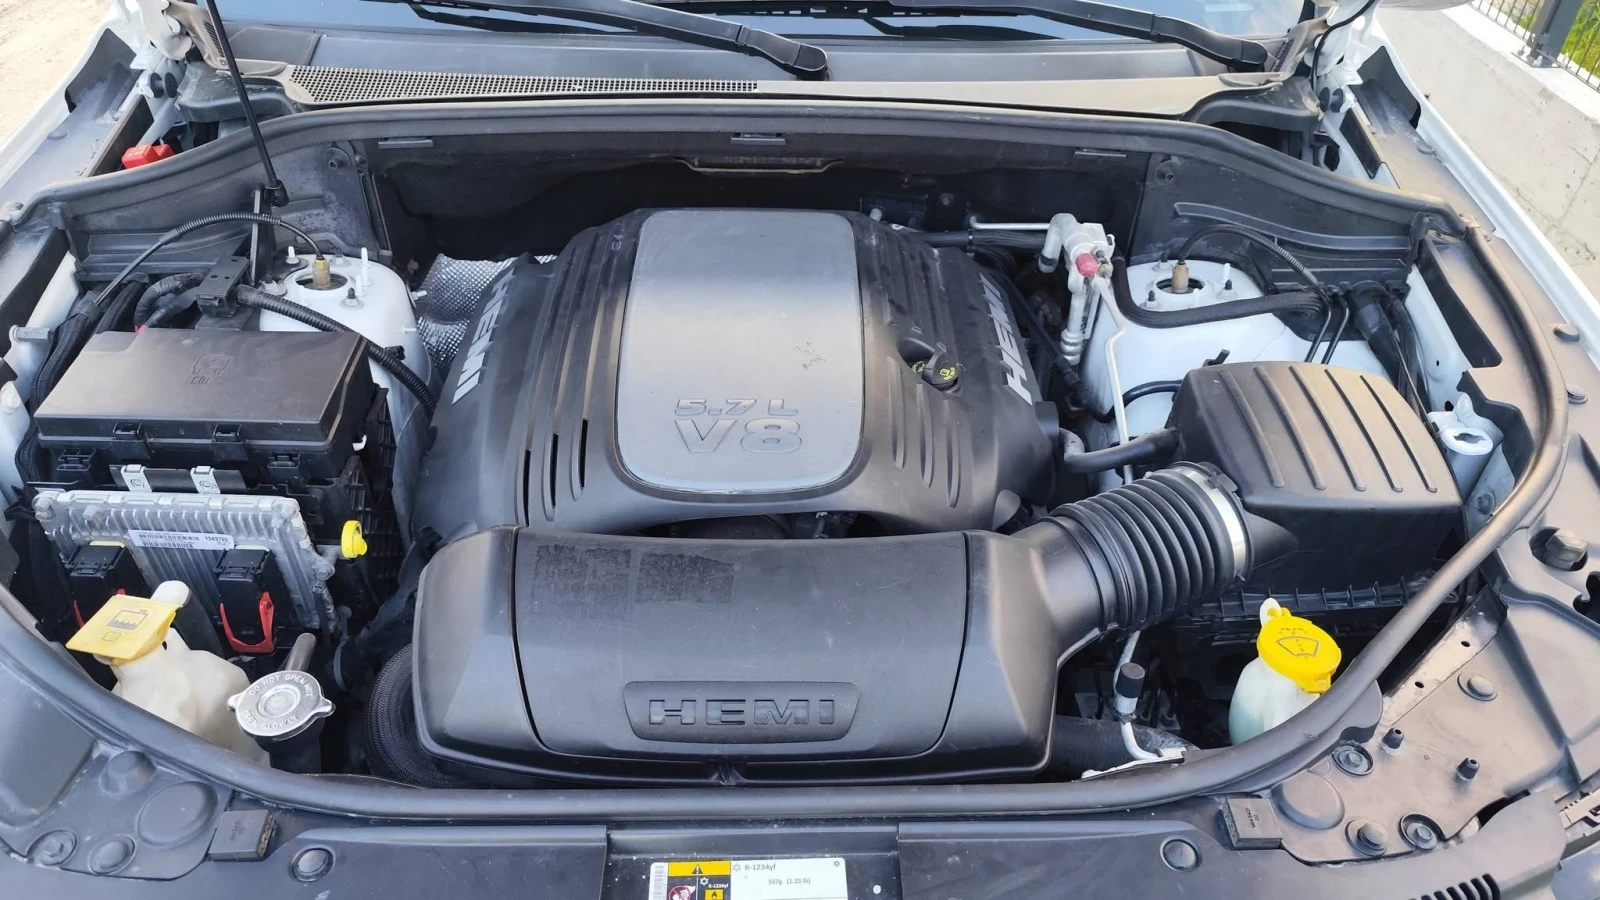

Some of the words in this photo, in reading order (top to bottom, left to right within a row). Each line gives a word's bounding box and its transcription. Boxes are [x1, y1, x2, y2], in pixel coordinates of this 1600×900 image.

[452, 267, 515, 405] HEMI
[978, 272, 1033, 406] HEMI
[675, 398, 757, 416] 5.7
[767, 398, 799, 416] L
[674, 417, 803, 454] V8
[249, 686, 261, 696] DO
[262, 675, 280, 685] NOT
[285, 673, 307, 684] OPEN
[649, 699, 835, 726] HEMI
[803, 877, 811, 885] lb)
